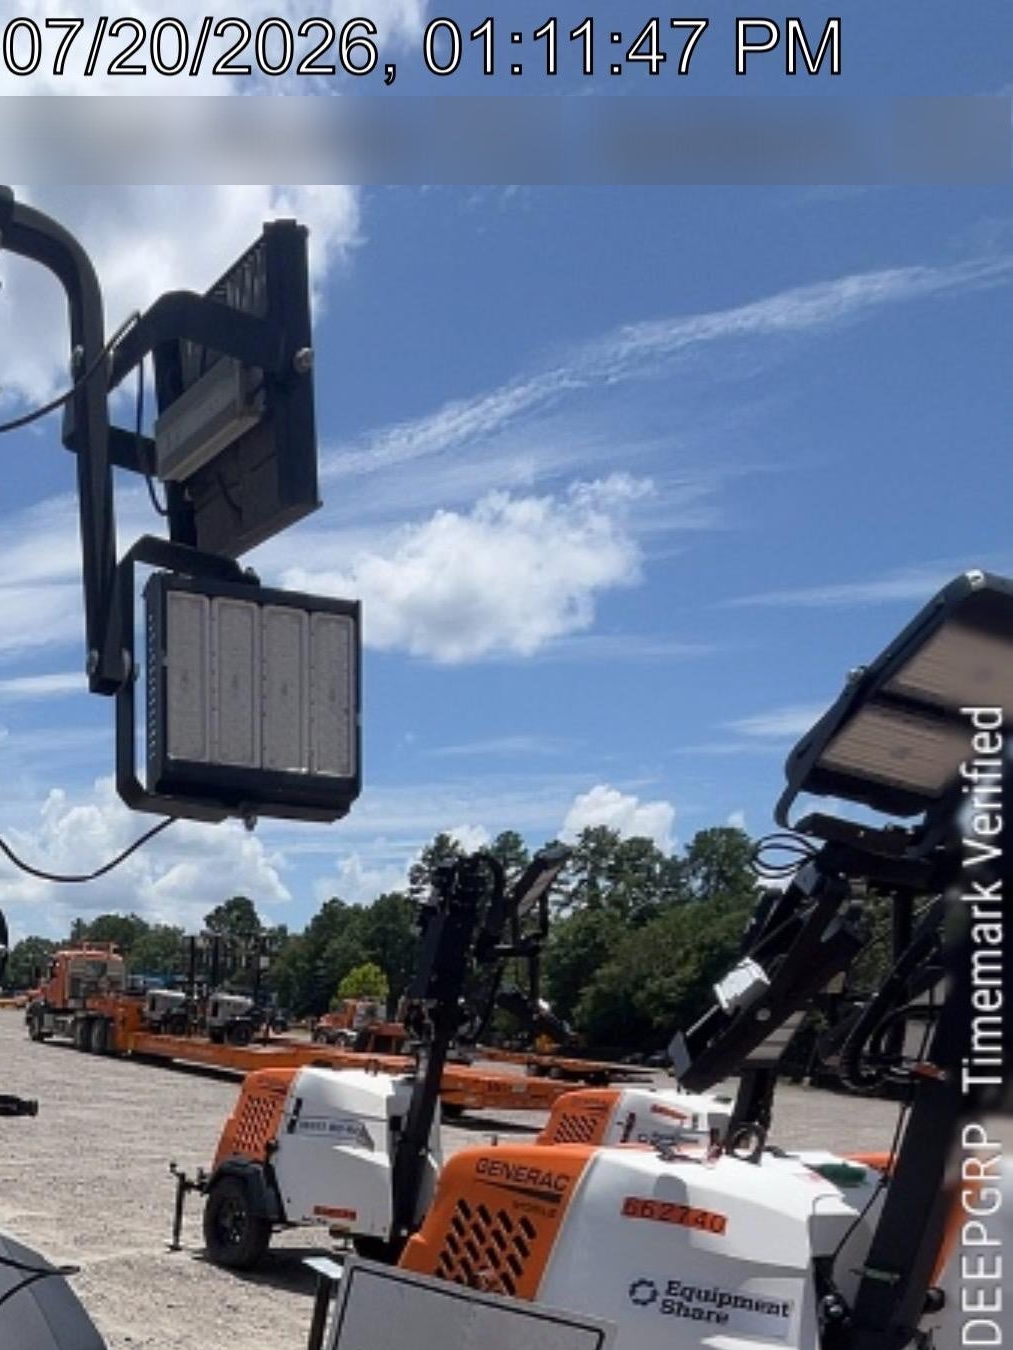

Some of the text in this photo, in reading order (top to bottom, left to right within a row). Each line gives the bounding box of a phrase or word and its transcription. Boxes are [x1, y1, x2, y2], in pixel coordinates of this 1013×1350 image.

[475, 1157, 570, 1191] GENERAC
[659, 1298, 730, 1325] Share
[664, 1279, 792, 1319] Equipment
